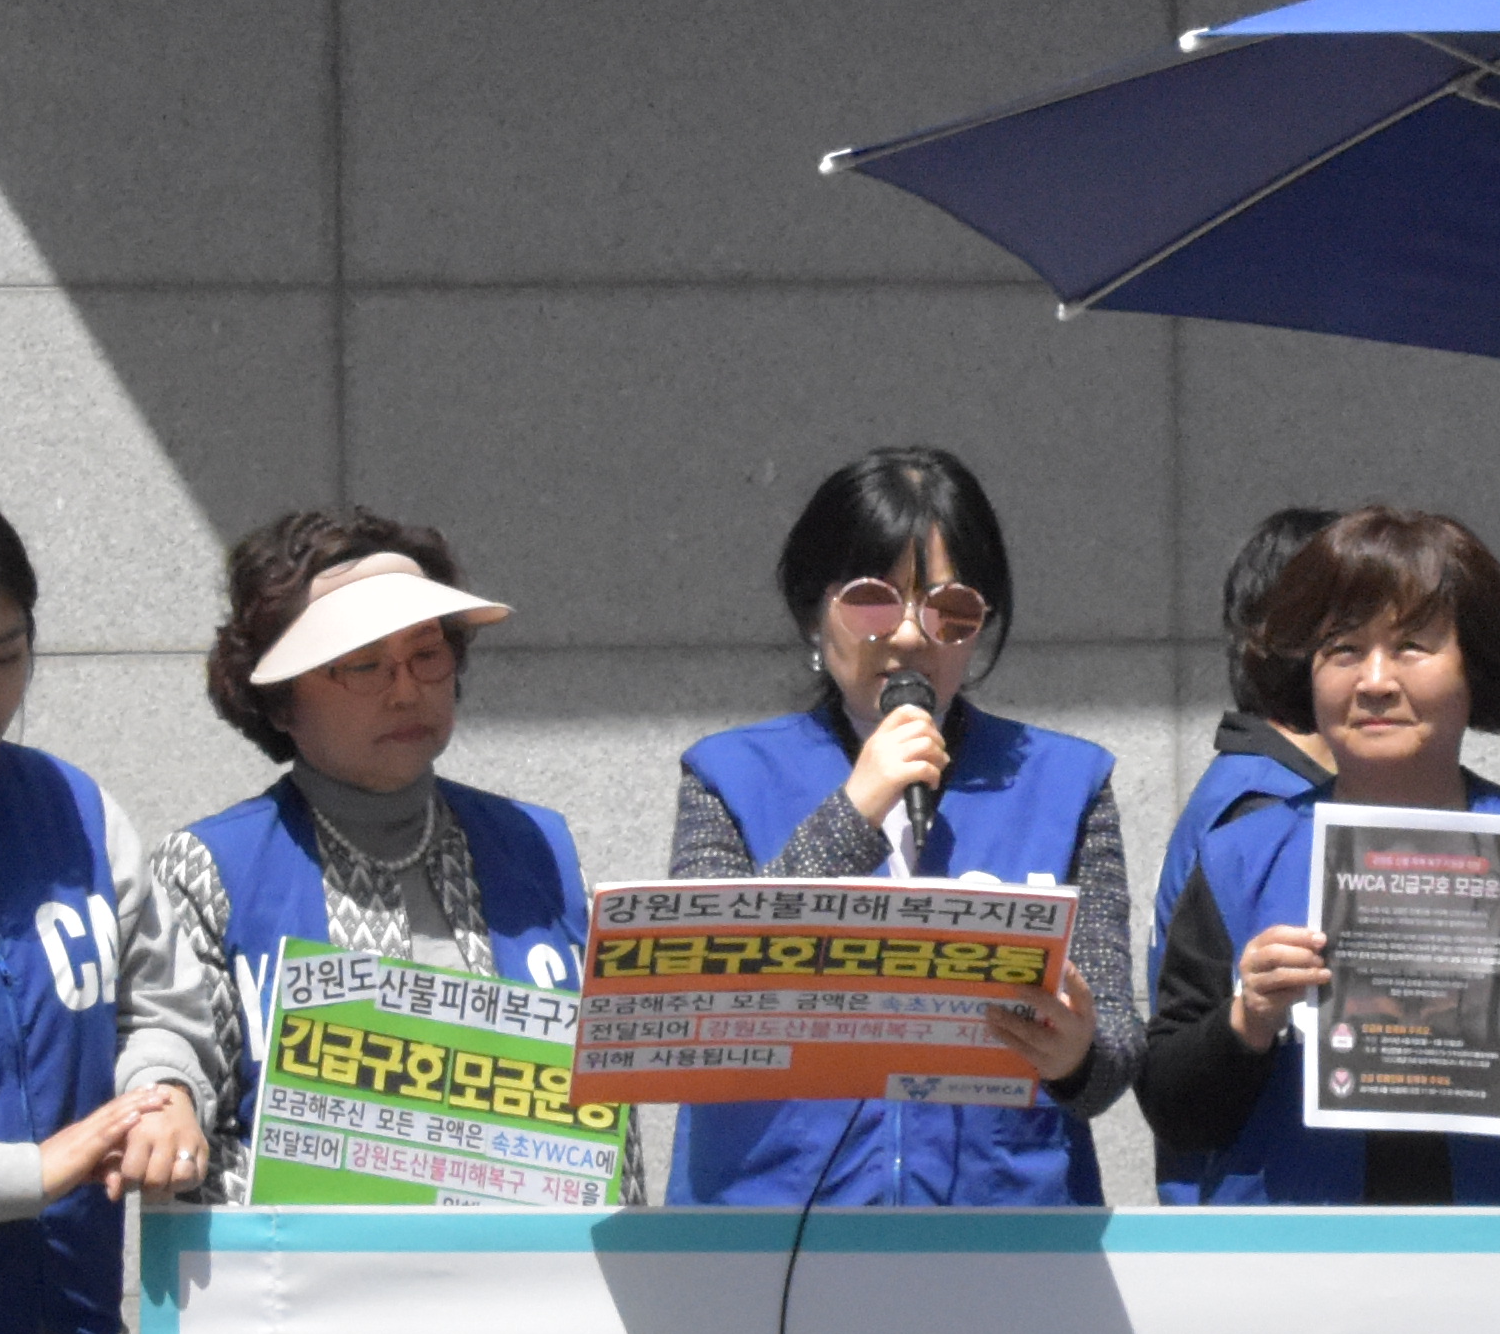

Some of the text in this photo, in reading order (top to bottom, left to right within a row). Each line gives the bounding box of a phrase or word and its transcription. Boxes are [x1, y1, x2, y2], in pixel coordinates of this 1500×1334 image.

[1336, 872, 1387, 892] YWCA
[1390, 873, 1450, 896] 긴급구호
[896, 896, 1056, 931] 복구지원
[597, 936, 821, 976] 긴급구호
[826, 939, 1046, 985] 모금운동
[286, 957, 377, 1004] 강원도
[380, 973, 499, 1025] 산불피해
[588, 992, 1038, 1021] 모금해주신 모든 금액은 속초YWC에
[591, 1020, 690, 1041] 전달되어
[707, 1017, 934, 1040] 강원도산불피해복구
[280, 1017, 444, 1103] 긴급구호
[585, 1047, 783, 1069] 위해 사용됩니다.
[267, 1088, 615, 1176] 모금해주신 모든 금액은 속초YWCA에
[263, 1125, 601, 1207] 전달되어 강원도산불피해복구 지원을
